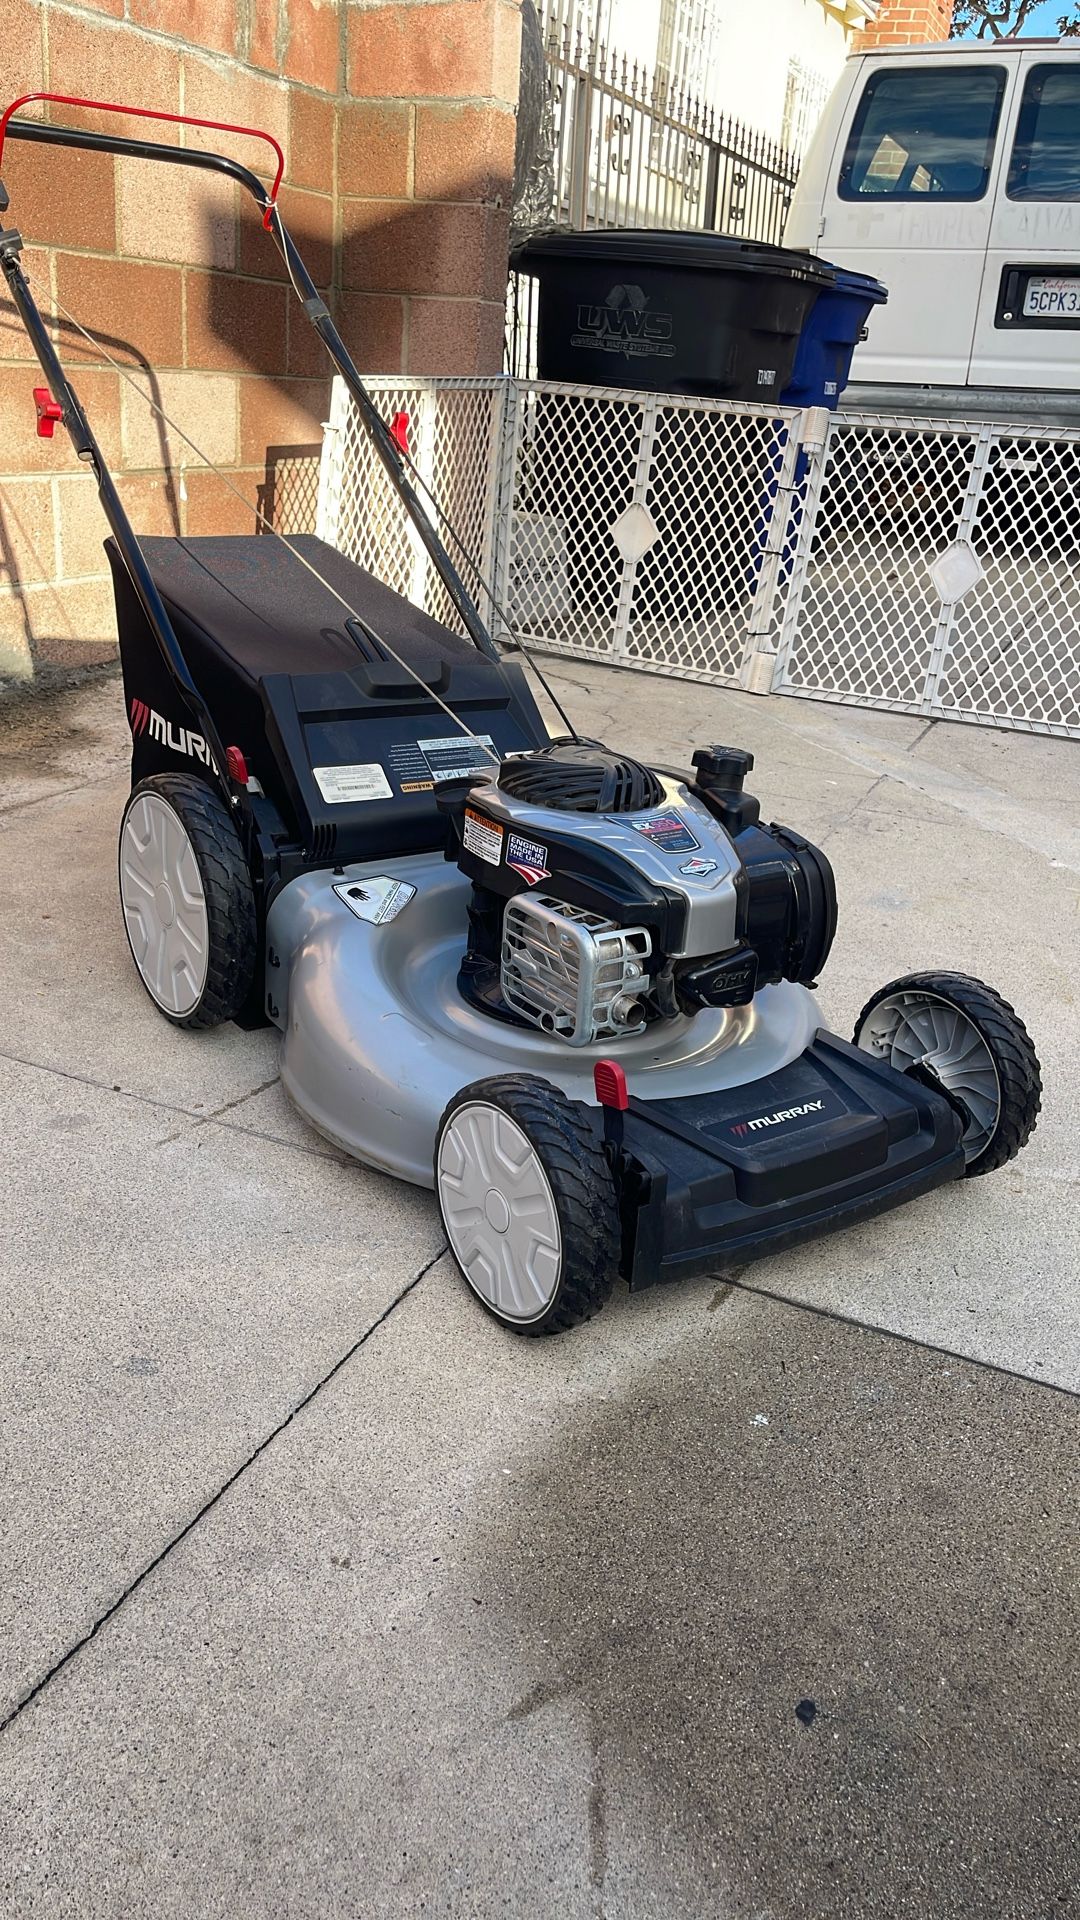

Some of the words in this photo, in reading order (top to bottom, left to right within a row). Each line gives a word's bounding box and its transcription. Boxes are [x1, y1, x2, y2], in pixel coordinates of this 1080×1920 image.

[577, 305, 673, 339] UWS
[509, 843, 533, 856] MADE
[534, 852, 544, 861] IN
[510, 837, 545, 854] ENGINE
[509, 848, 523, 858] THE
[525, 854, 543, 866] USA
[747, 1100, 823, 1131] MURRAY
